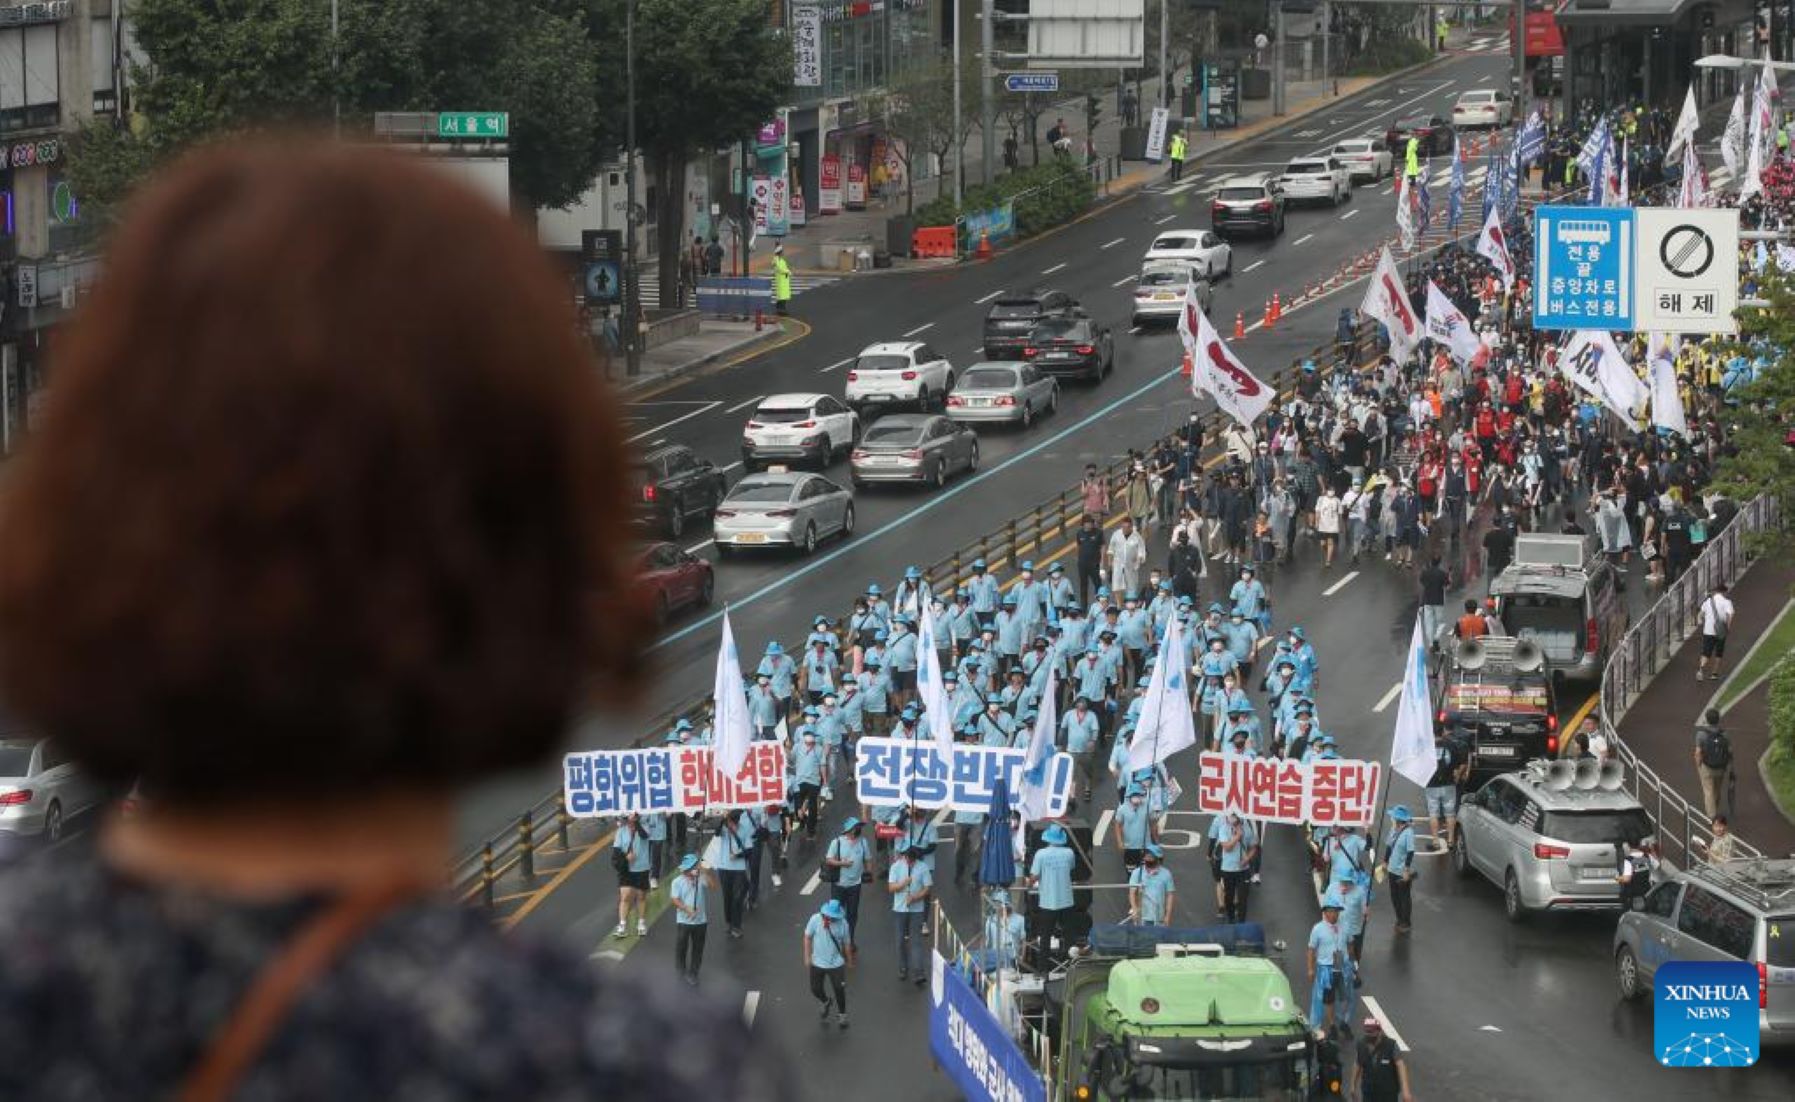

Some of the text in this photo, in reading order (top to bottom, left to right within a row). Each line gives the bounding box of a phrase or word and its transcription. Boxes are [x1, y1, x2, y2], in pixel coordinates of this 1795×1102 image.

[445, 117, 499, 133] 서울역
[1567, 245, 1601, 261] 전용
[1551, 279, 1617, 295] 중앙차로
[1550, 299, 1617, 316] 버스전용
[1659, 293, 1713, 313] 해제
[567, 752, 674, 813] 평화위협
[1201, 757, 1378, 822] 군사연습 중단!
